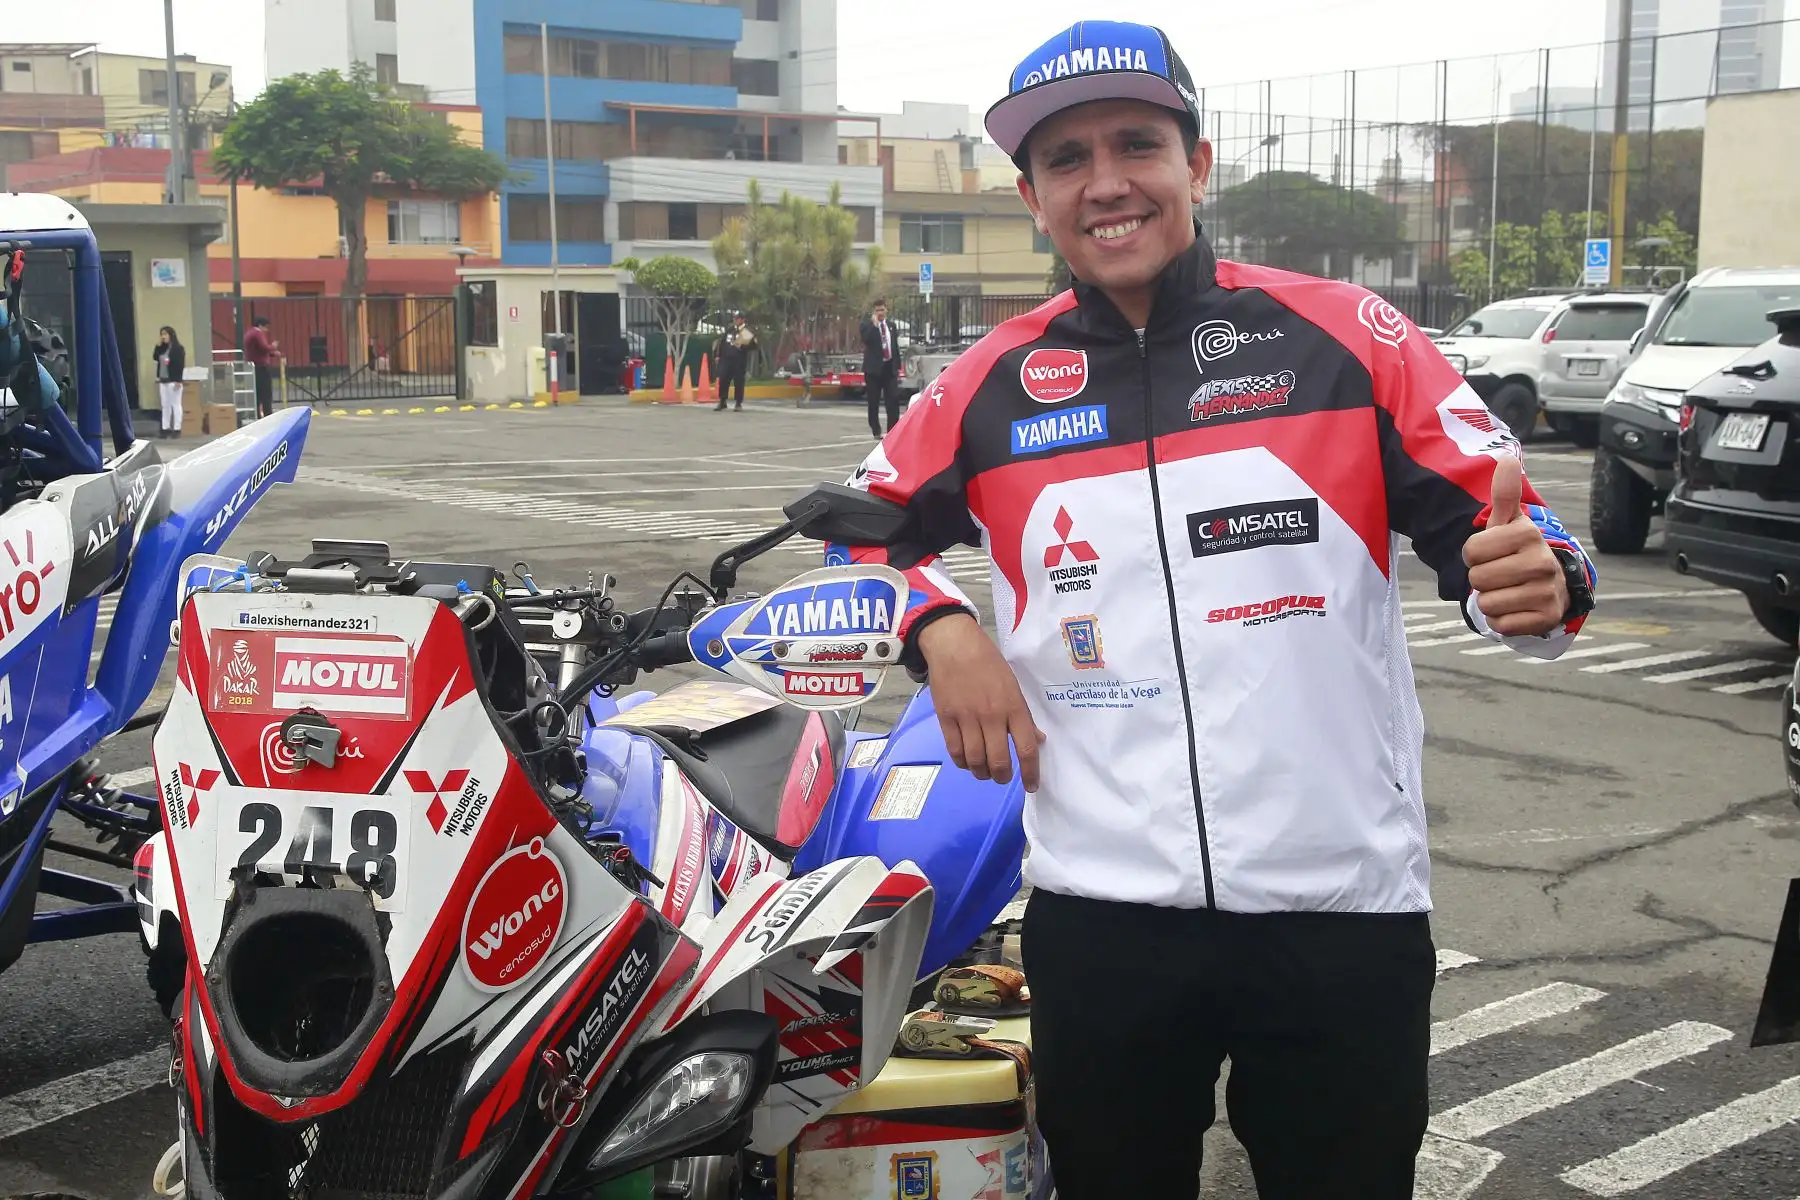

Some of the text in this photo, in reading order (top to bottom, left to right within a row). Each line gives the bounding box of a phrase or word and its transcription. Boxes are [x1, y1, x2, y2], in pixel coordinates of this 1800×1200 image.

[1041, 46, 1148, 81] YAMAHA
[1191, 319, 1285, 374] Perú
[1036, 386, 1074, 395] cencosud
[1191, 386, 1290, 421] HERNANDEZ
[1016, 409, 1104, 448] YAMAHA
[250, 440, 288, 495] 1000R
[84, 514, 120, 558] ALL
[1198, 510, 1309, 539] COMSATEL
[1202, 528, 1308, 549] seguridad y control satelital
[1055, 579, 1091, 594] MOTORS
[250, 615, 369, 630] alexishernandez321
[765, 597, 890, 636] YAMAHA
[1202, 596, 1326, 623] SOCOPUR
[1243, 609, 1326, 627] MOTORSPORTS
[223, 675, 260, 695] DAKAR
[281, 659, 399, 690] MOTUL
[788, 674, 860, 693] MOTUL
[1072, 680, 1120, 688] Universidad
[228, 696, 253, 705] 2018
[1045, 686, 1161, 701] Inca Garcilaso de la Vega
[164, 783, 179, 826] MOTORS
[171, 768, 188, 830] MITSUBISHI
[443, 777, 481, 838] MITSUBISHI
[459, 793, 488, 837] MOTORS
[237, 802, 398, 900] 248
[671, 866, 694, 911] ALEXIS
[499, 925, 551, 979] cencosud
[565, 948, 647, 1068] MSATEL
[590, 1010, 619, 1051] control
[620, 963, 651, 1009] satelital
[781, 1054, 832, 1073] YOUNG
